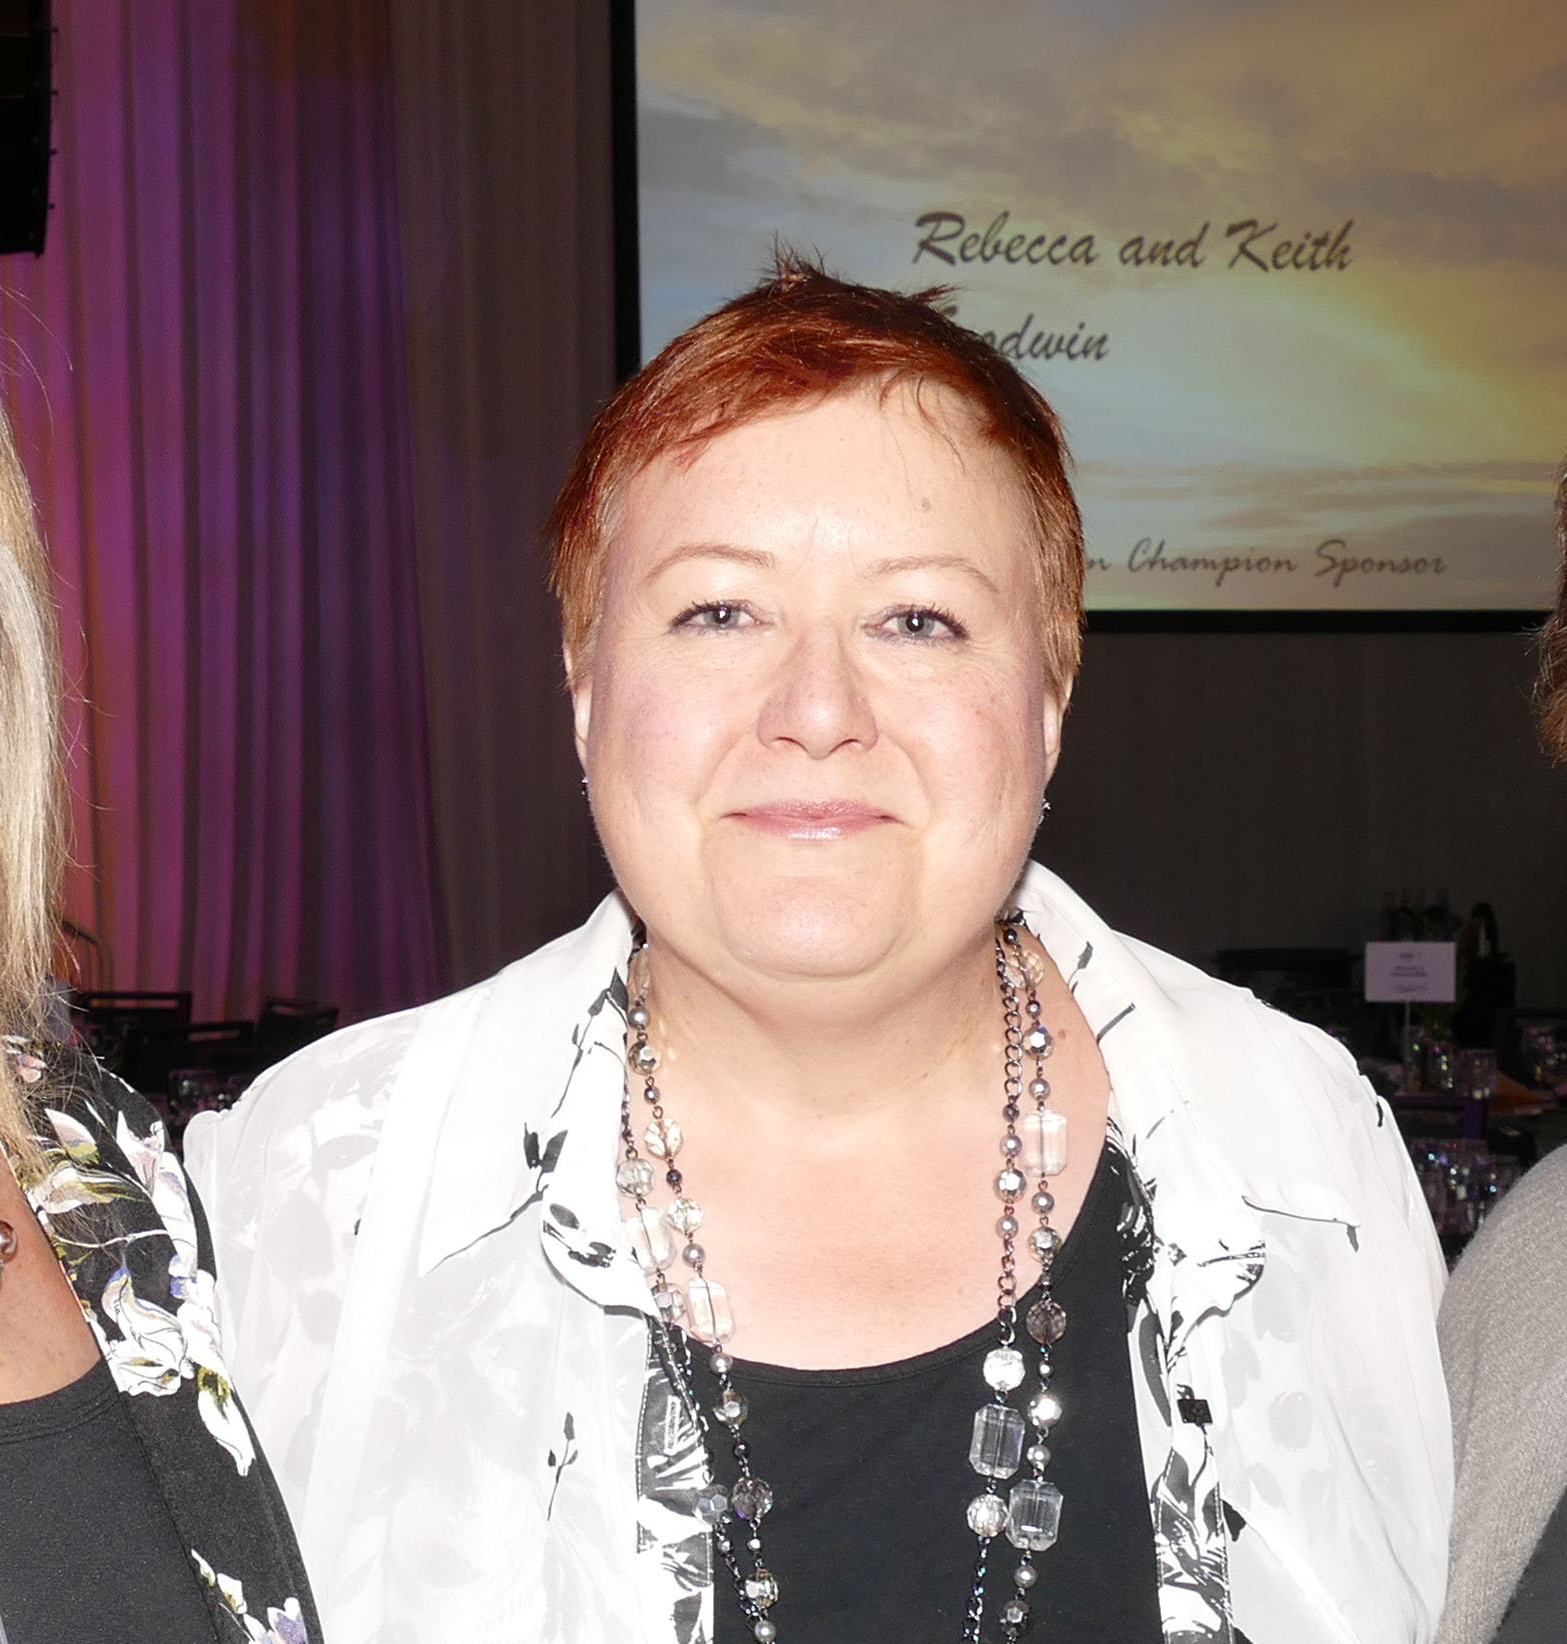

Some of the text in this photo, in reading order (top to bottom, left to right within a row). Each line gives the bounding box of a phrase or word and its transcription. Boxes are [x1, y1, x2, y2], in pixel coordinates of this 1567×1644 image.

[911, 209, 1356, 274] Rebecca and Keith
[941, 304, 1111, 361] odwin
[1128, 536, 1448, 589] Champion Sponsor
